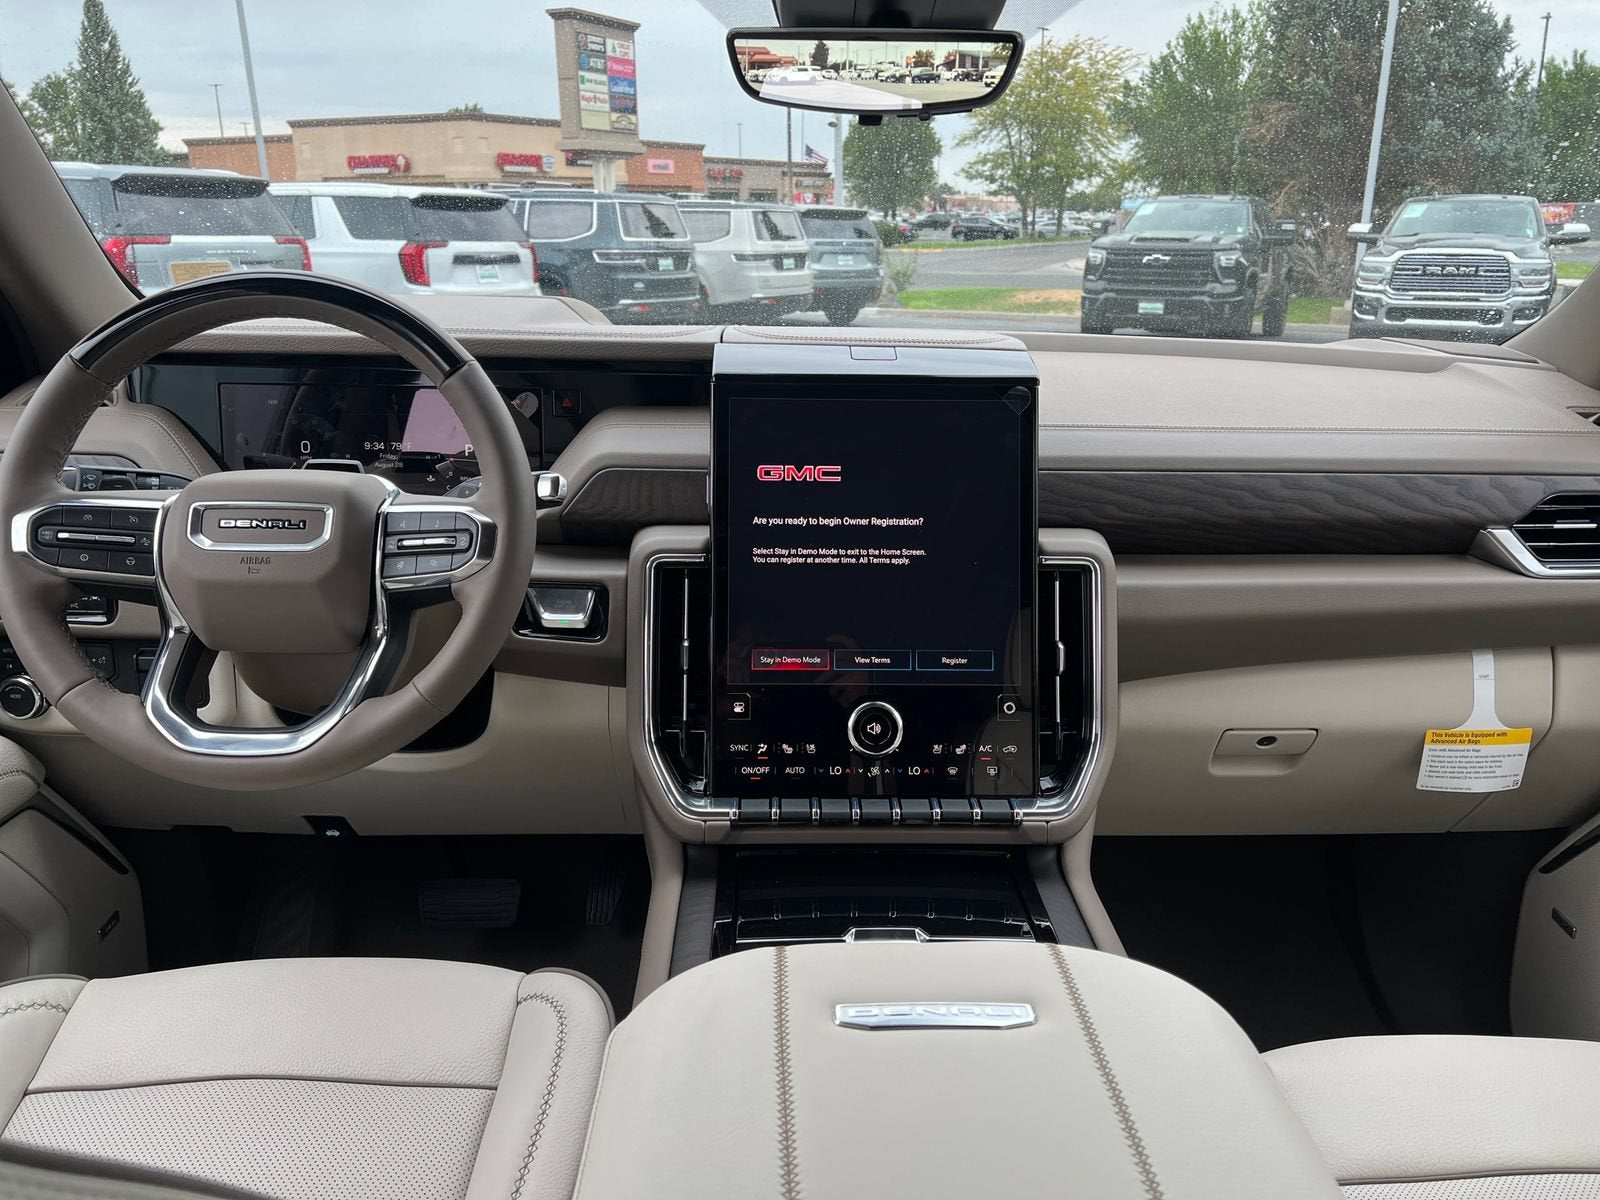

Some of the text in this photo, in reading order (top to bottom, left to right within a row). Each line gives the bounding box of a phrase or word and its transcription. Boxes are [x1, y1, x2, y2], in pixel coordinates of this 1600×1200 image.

[1424, 266, 1476, 274] RAM
[300, 440, 310, 454] 0
[364, 442, 385, 450] 9:34
[390, 442, 402, 450] 79
[464, 444, 474, 456] P
[756, 464, 842, 482] GMC
[219, 518, 306, 529] DENALI
[752, 516, 767, 524] Are
[768, 518, 784, 526] you
[784, 516, 807, 526] ready
[819, 516, 841, 527] begin
[843, 517, 869, 525] Owner
[871, 517, 924, 527] Registration?
[774, 548, 789, 556] Stay
[240, 556, 271, 566] AIRBAG
[891, 557, 911, 566] apply.
[760, 656, 773, 664] Stay
[941, 657, 968, 665] Register
[741, 766, 770, 775] ON/OFF
[830, 766, 842, 775] LO
[908, 766, 921, 775] LO
[848, 1006, 1028, 1017] DENALI
